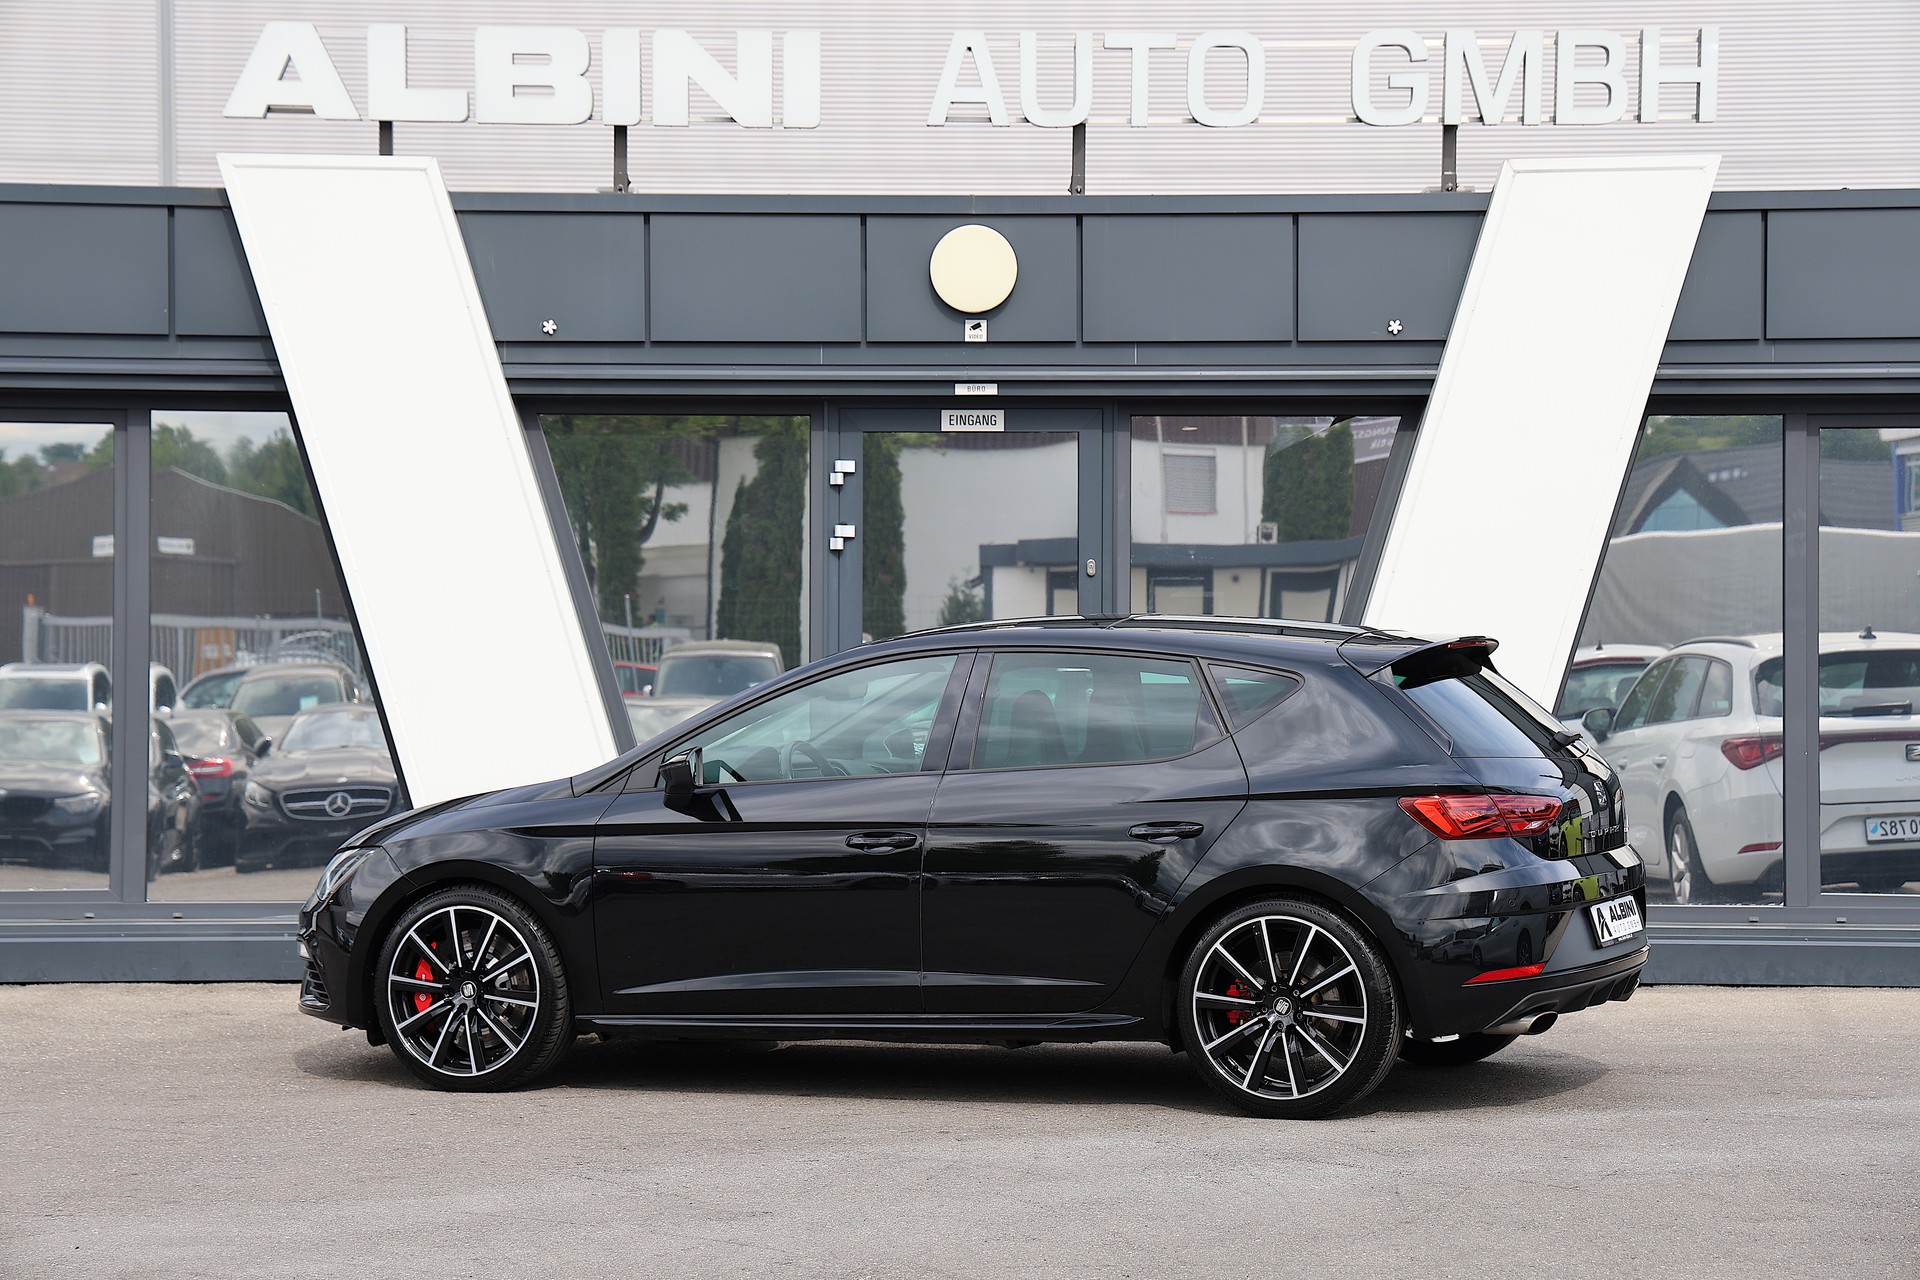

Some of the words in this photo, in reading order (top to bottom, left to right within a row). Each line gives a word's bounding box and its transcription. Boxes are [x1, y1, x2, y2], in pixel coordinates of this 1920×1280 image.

[223, 21, 821, 129] ALBINI
[927, 30, 1266, 127] AUTO
[1351, 27, 1720, 127] GMBH
[966, 385, 986, 393] BÜRO
[948, 414, 997, 426] EINGANG
[1609, 899, 1637, 923] ALBINI
